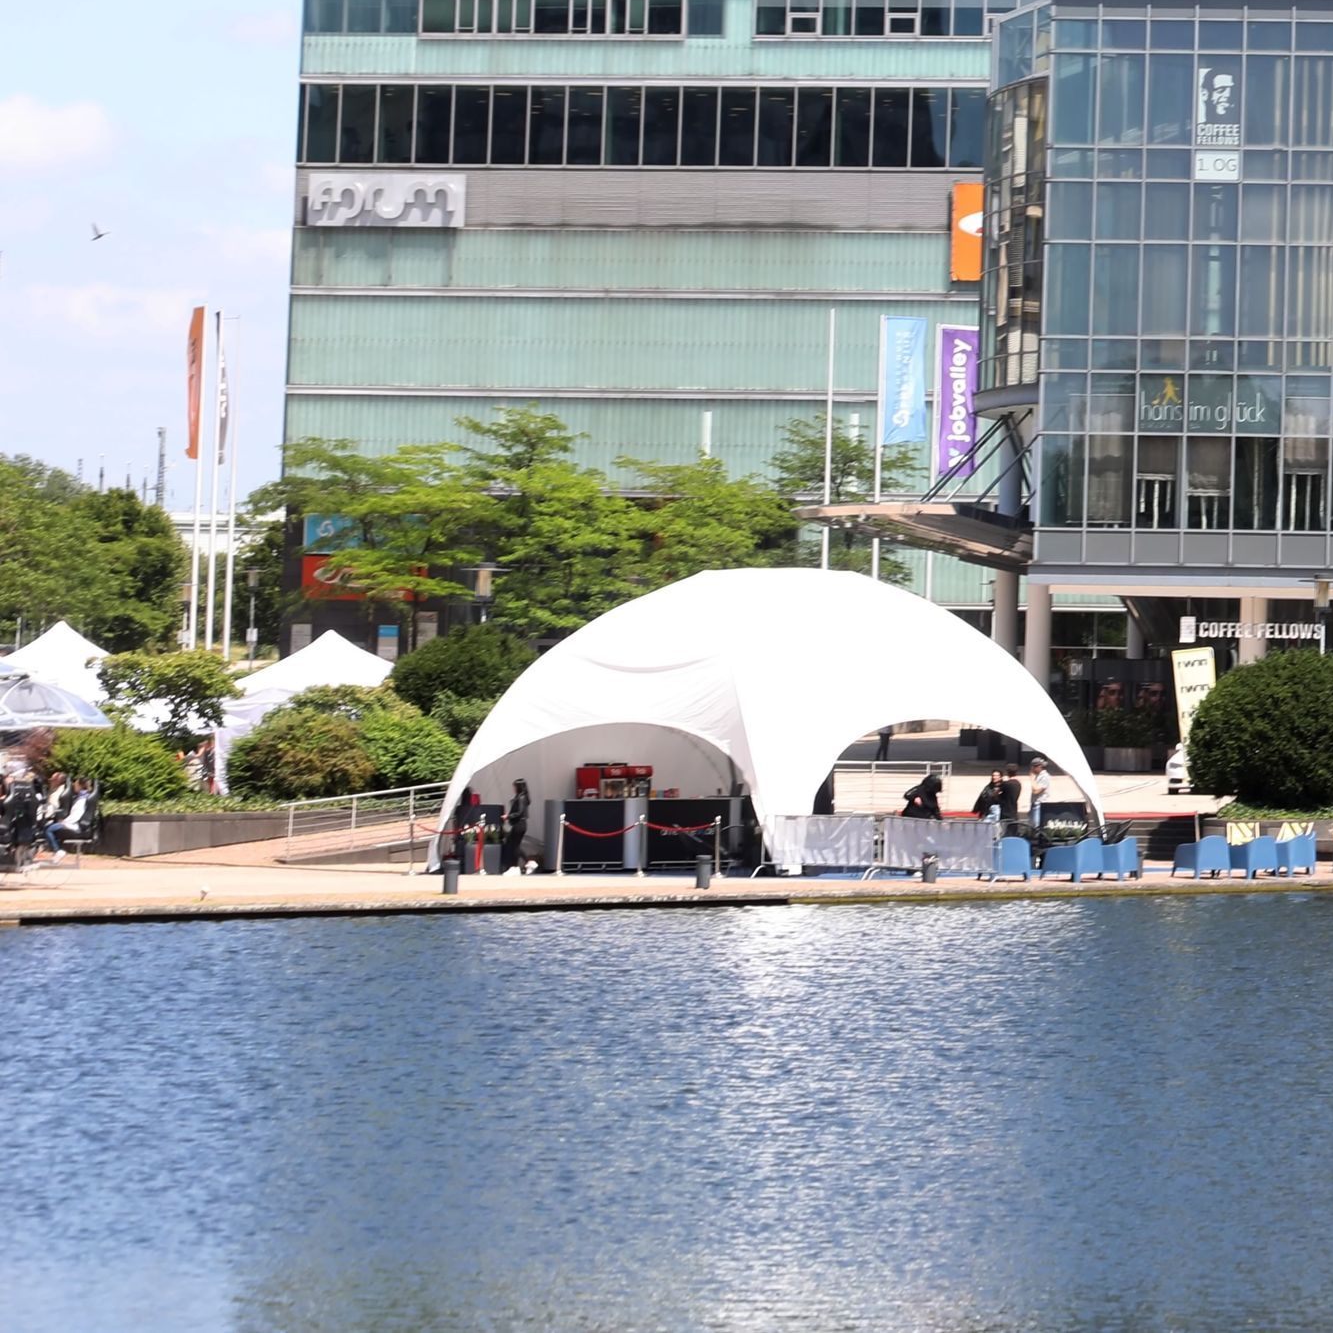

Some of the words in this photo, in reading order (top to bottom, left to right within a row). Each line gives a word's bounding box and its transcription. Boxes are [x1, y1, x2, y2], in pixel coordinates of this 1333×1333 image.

[1197, 123, 1241, 136] COFFEE
[1197, 136, 1240, 145] FELLOWS
[1213, 158, 1238, 172] OG
[947, 338, 972, 443] jobvalley
[1140, 390, 1183, 422] hans
[1188, 401, 1211, 422] im
[1214, 391, 1267, 431] glück
[1199, 621, 1254, 639] COFFEE
[1256, 622, 1323, 640] FELLOWS
